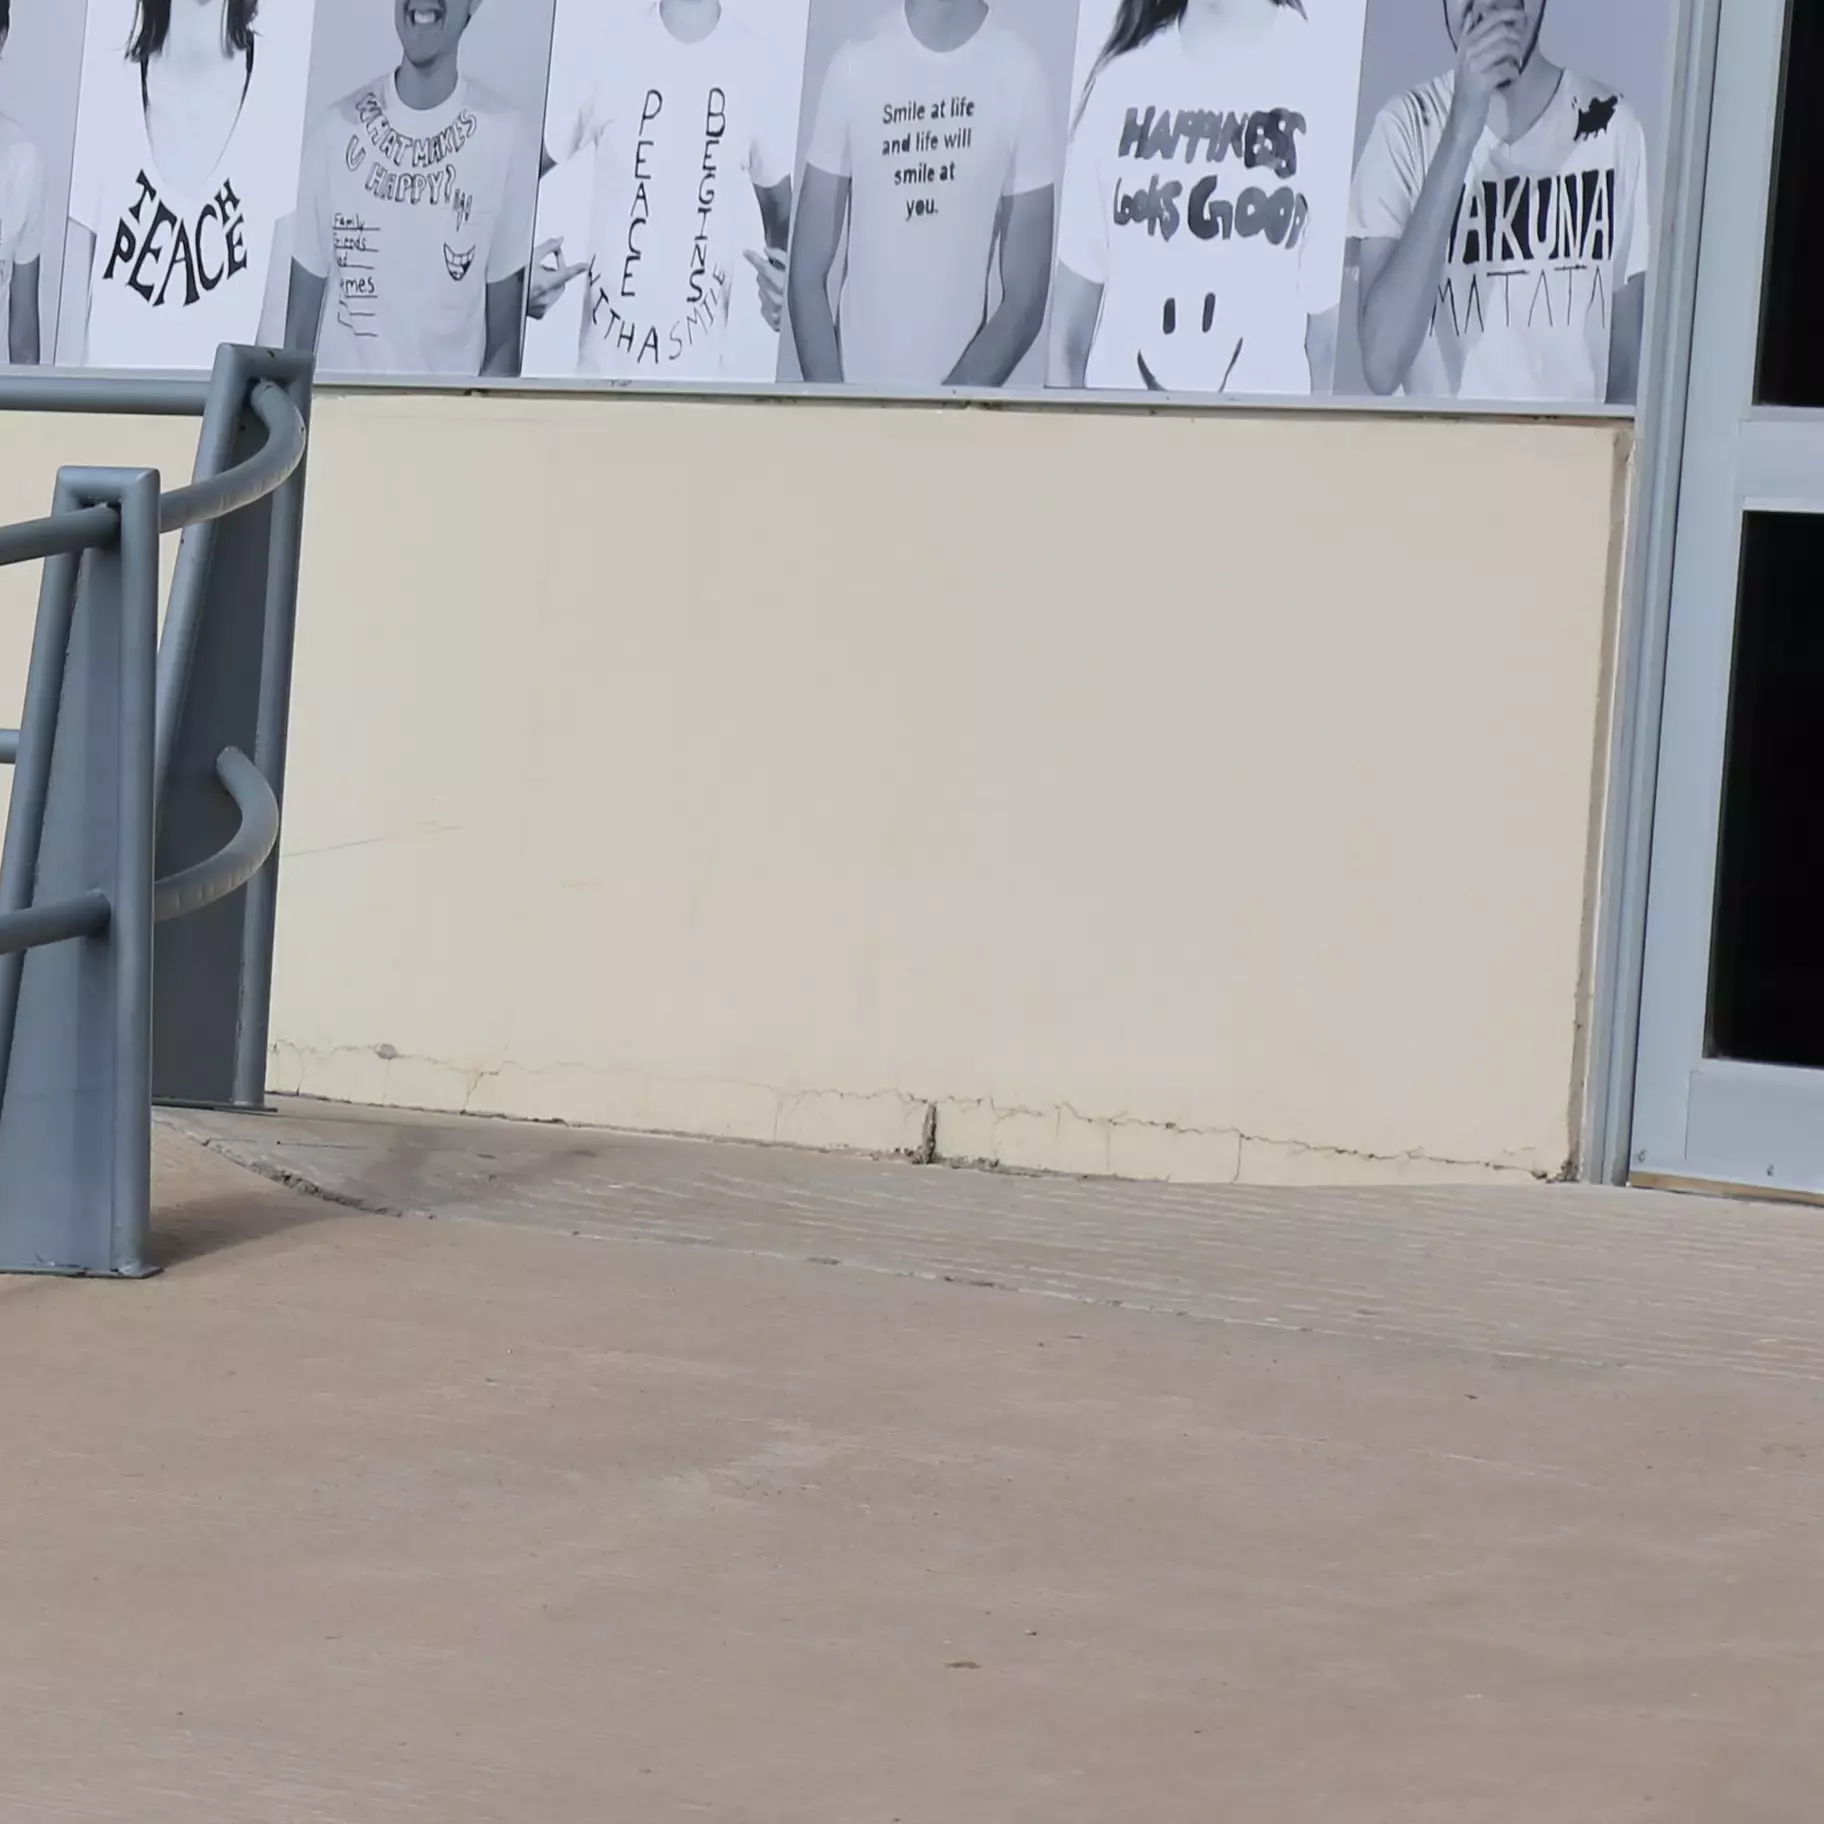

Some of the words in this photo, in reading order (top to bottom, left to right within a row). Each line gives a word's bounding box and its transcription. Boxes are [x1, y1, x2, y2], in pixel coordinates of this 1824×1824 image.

[355, 91, 413, 168] WHAT
[412, 107, 478, 169] MAKES
[882, 100, 926, 124] Smile
[931, 98, 946, 119] at
[951, 96, 975, 117] life
[345, 133, 367, 172] U
[882, 132, 911, 156] and
[915, 130, 939, 152] life
[944, 127, 972, 148] will
[364, 163, 457, 206] HAPPY?
[620, 88, 664, 297] PEACE
[894, 162, 935, 186] smile
[939, 160, 956, 181] at
[686, 87, 727, 303] BEGINS
[905, 198, 939, 222] you.
[1446, 167, 1616, 265] AKUNA
[1428, 264, 1607, 337] MATATA
[636, 325, 659, 364] A
